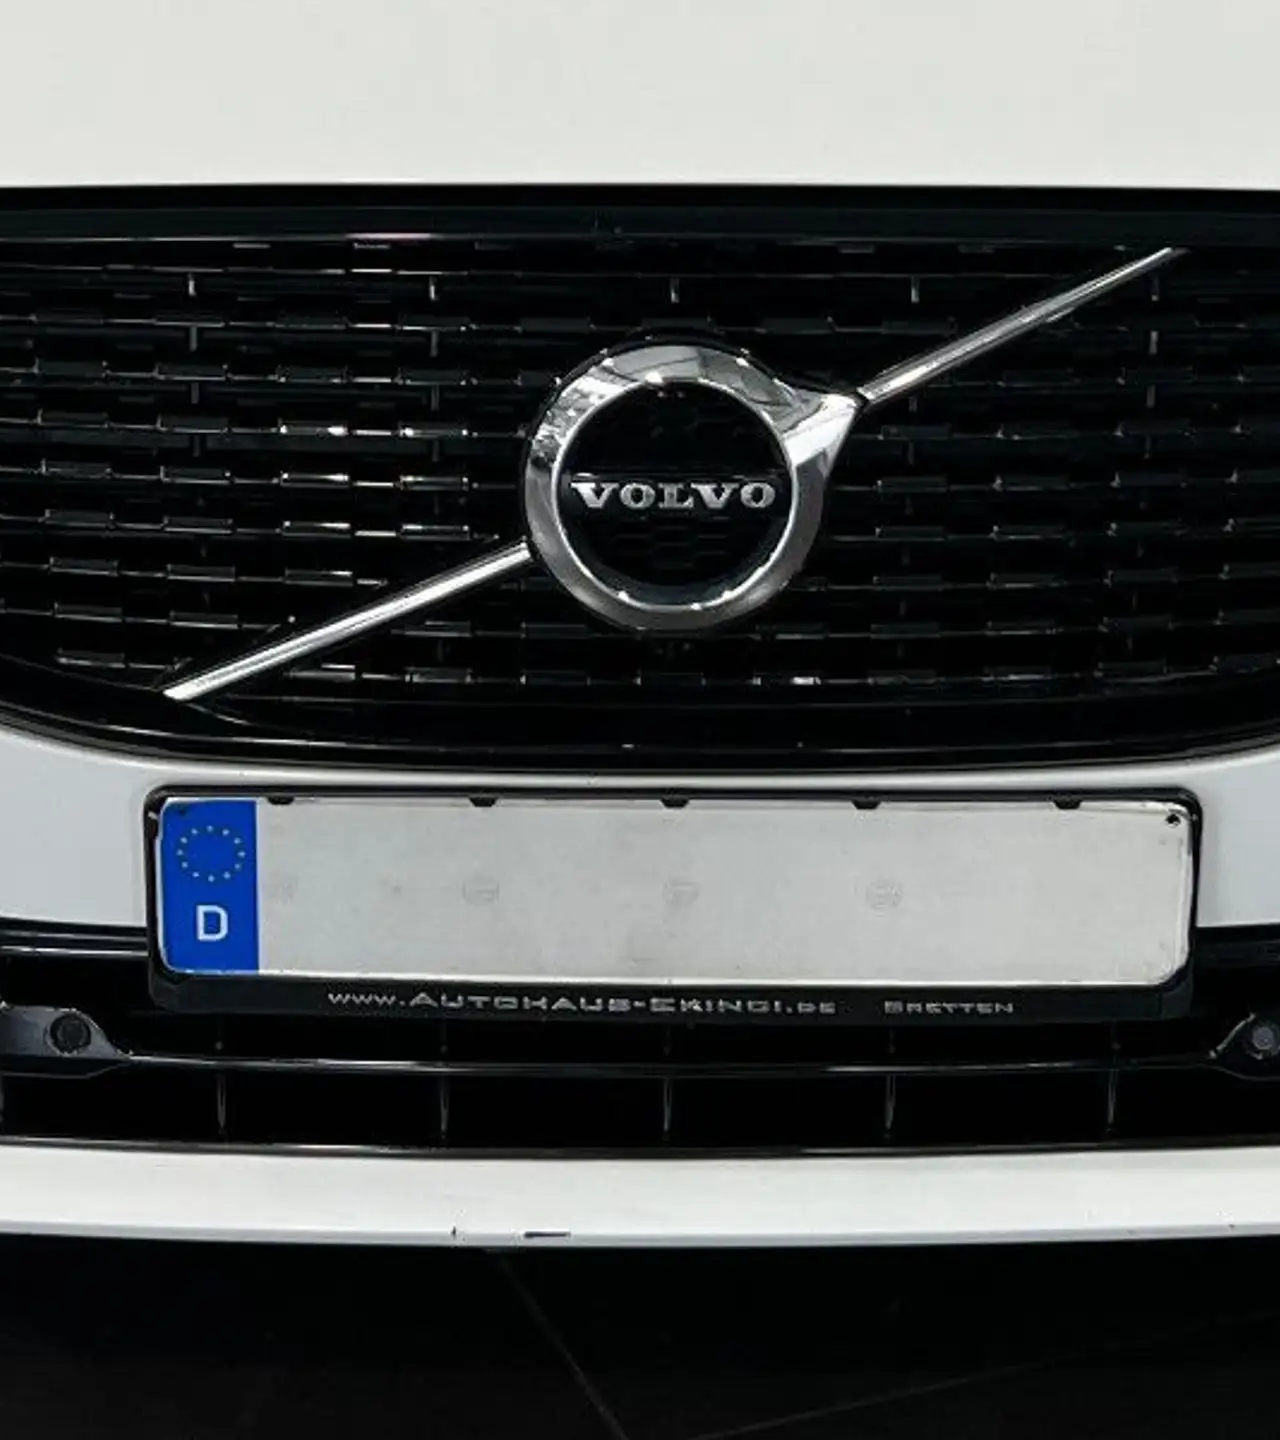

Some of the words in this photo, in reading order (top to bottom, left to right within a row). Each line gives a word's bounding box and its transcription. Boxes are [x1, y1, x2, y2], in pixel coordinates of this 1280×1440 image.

[570, 481, 776, 509] VOLVO
[196, 904, 228, 941] D
[884, 1000, 1014, 1015] BRETTEN
